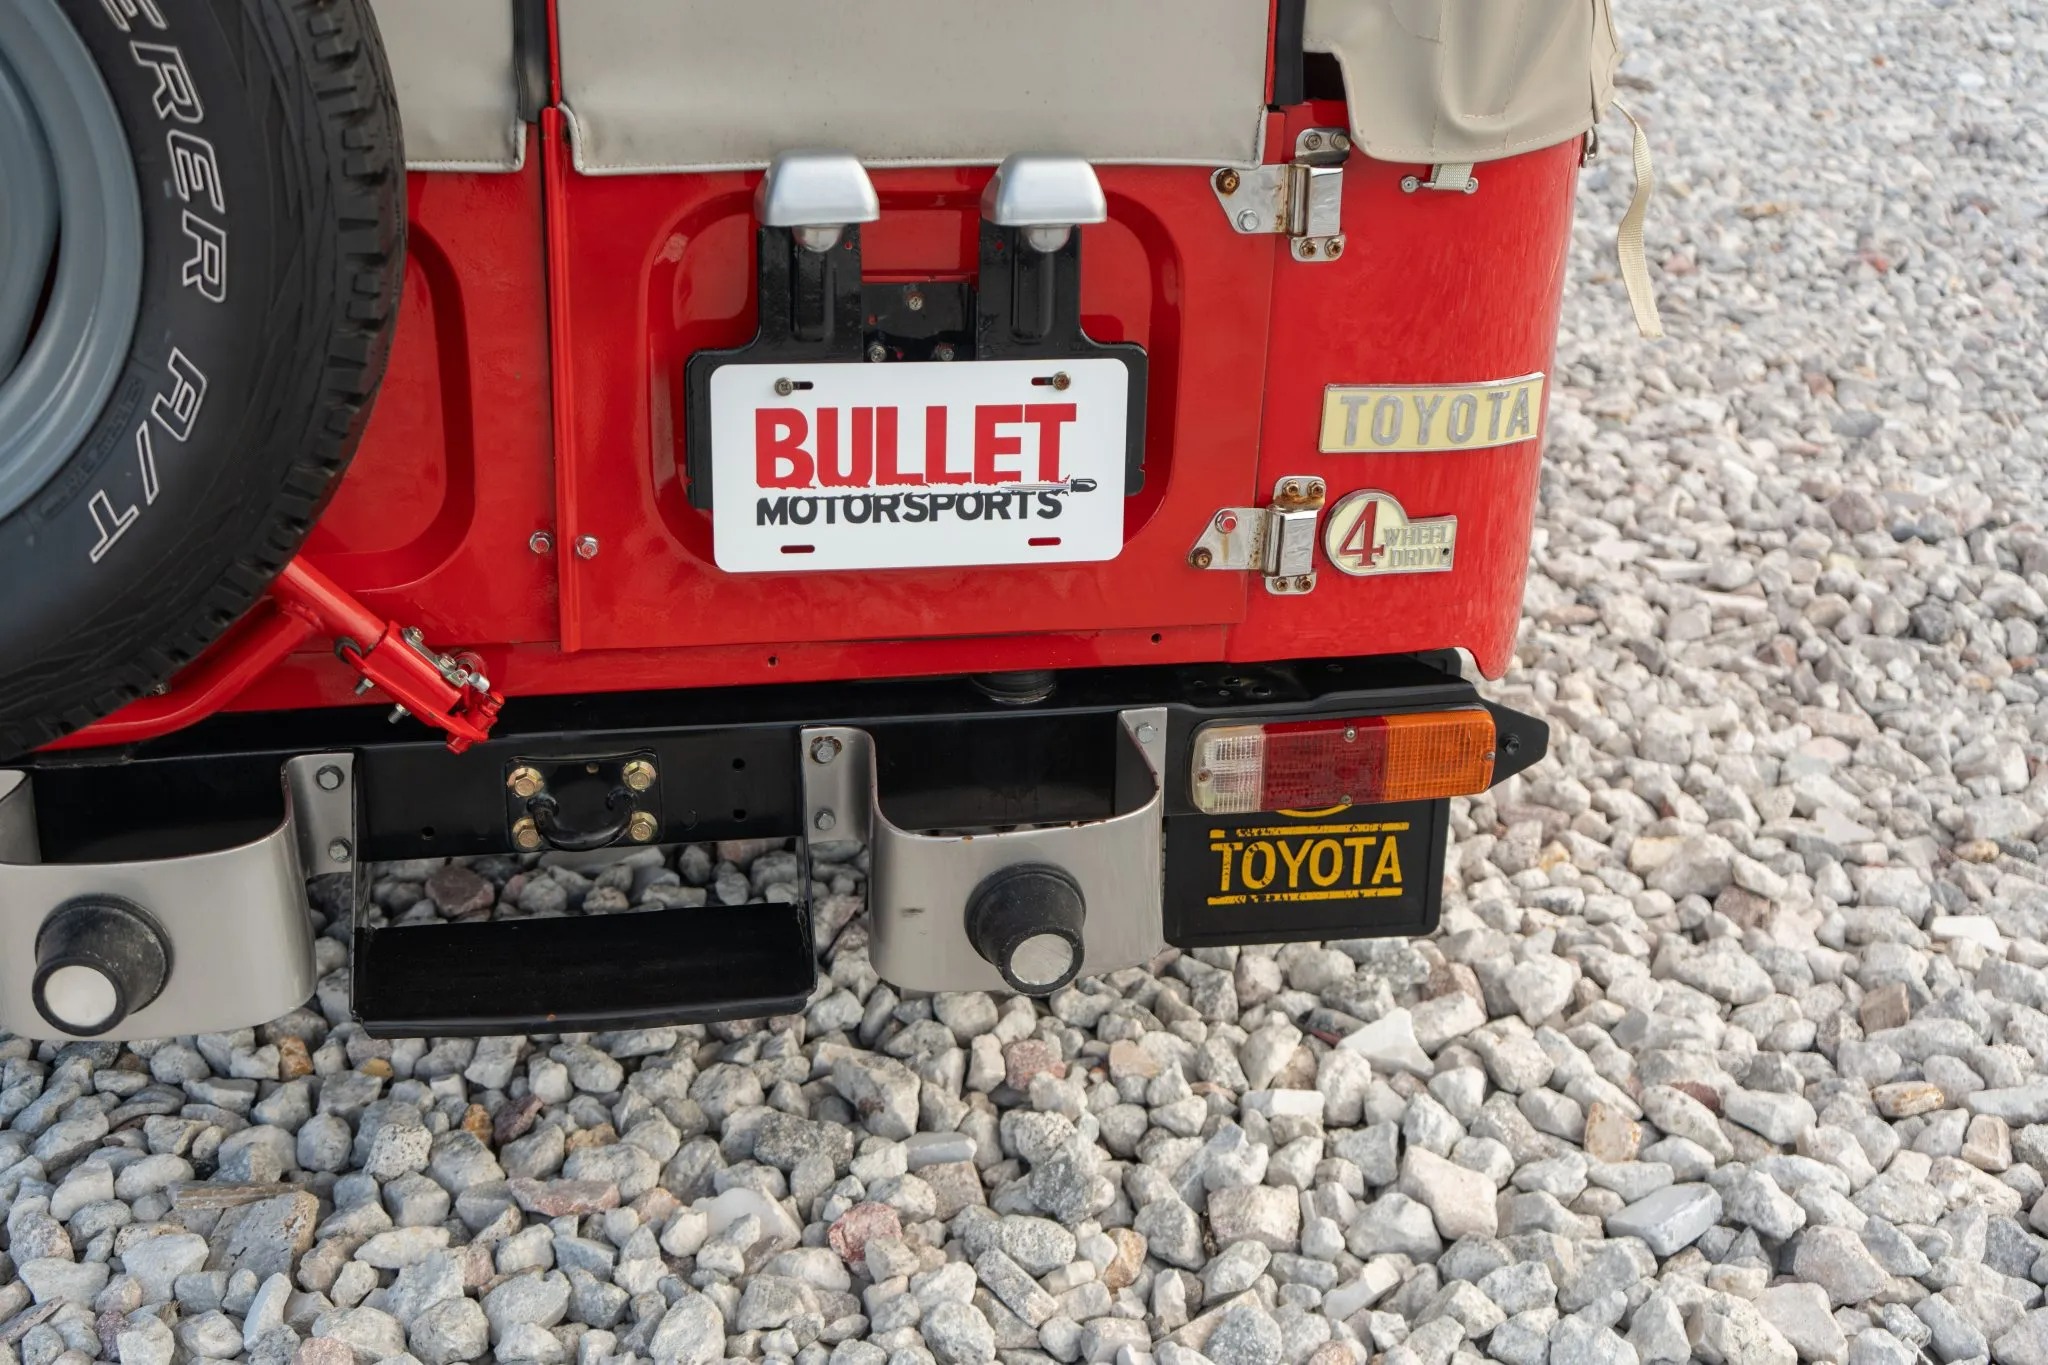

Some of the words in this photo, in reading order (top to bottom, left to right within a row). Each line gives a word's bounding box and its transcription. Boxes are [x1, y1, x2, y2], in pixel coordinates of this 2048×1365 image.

[1340, 387, 1530, 446] TOYOTA
[755, 403, 1077, 489] BULLET
[756, 489, 1064, 526] MOTORSPORTS
[1338, 500, 1385, 567] 4
[1384, 525, 1450, 546] WHEEL
[1210, 835, 1403, 891] TOYOTA
